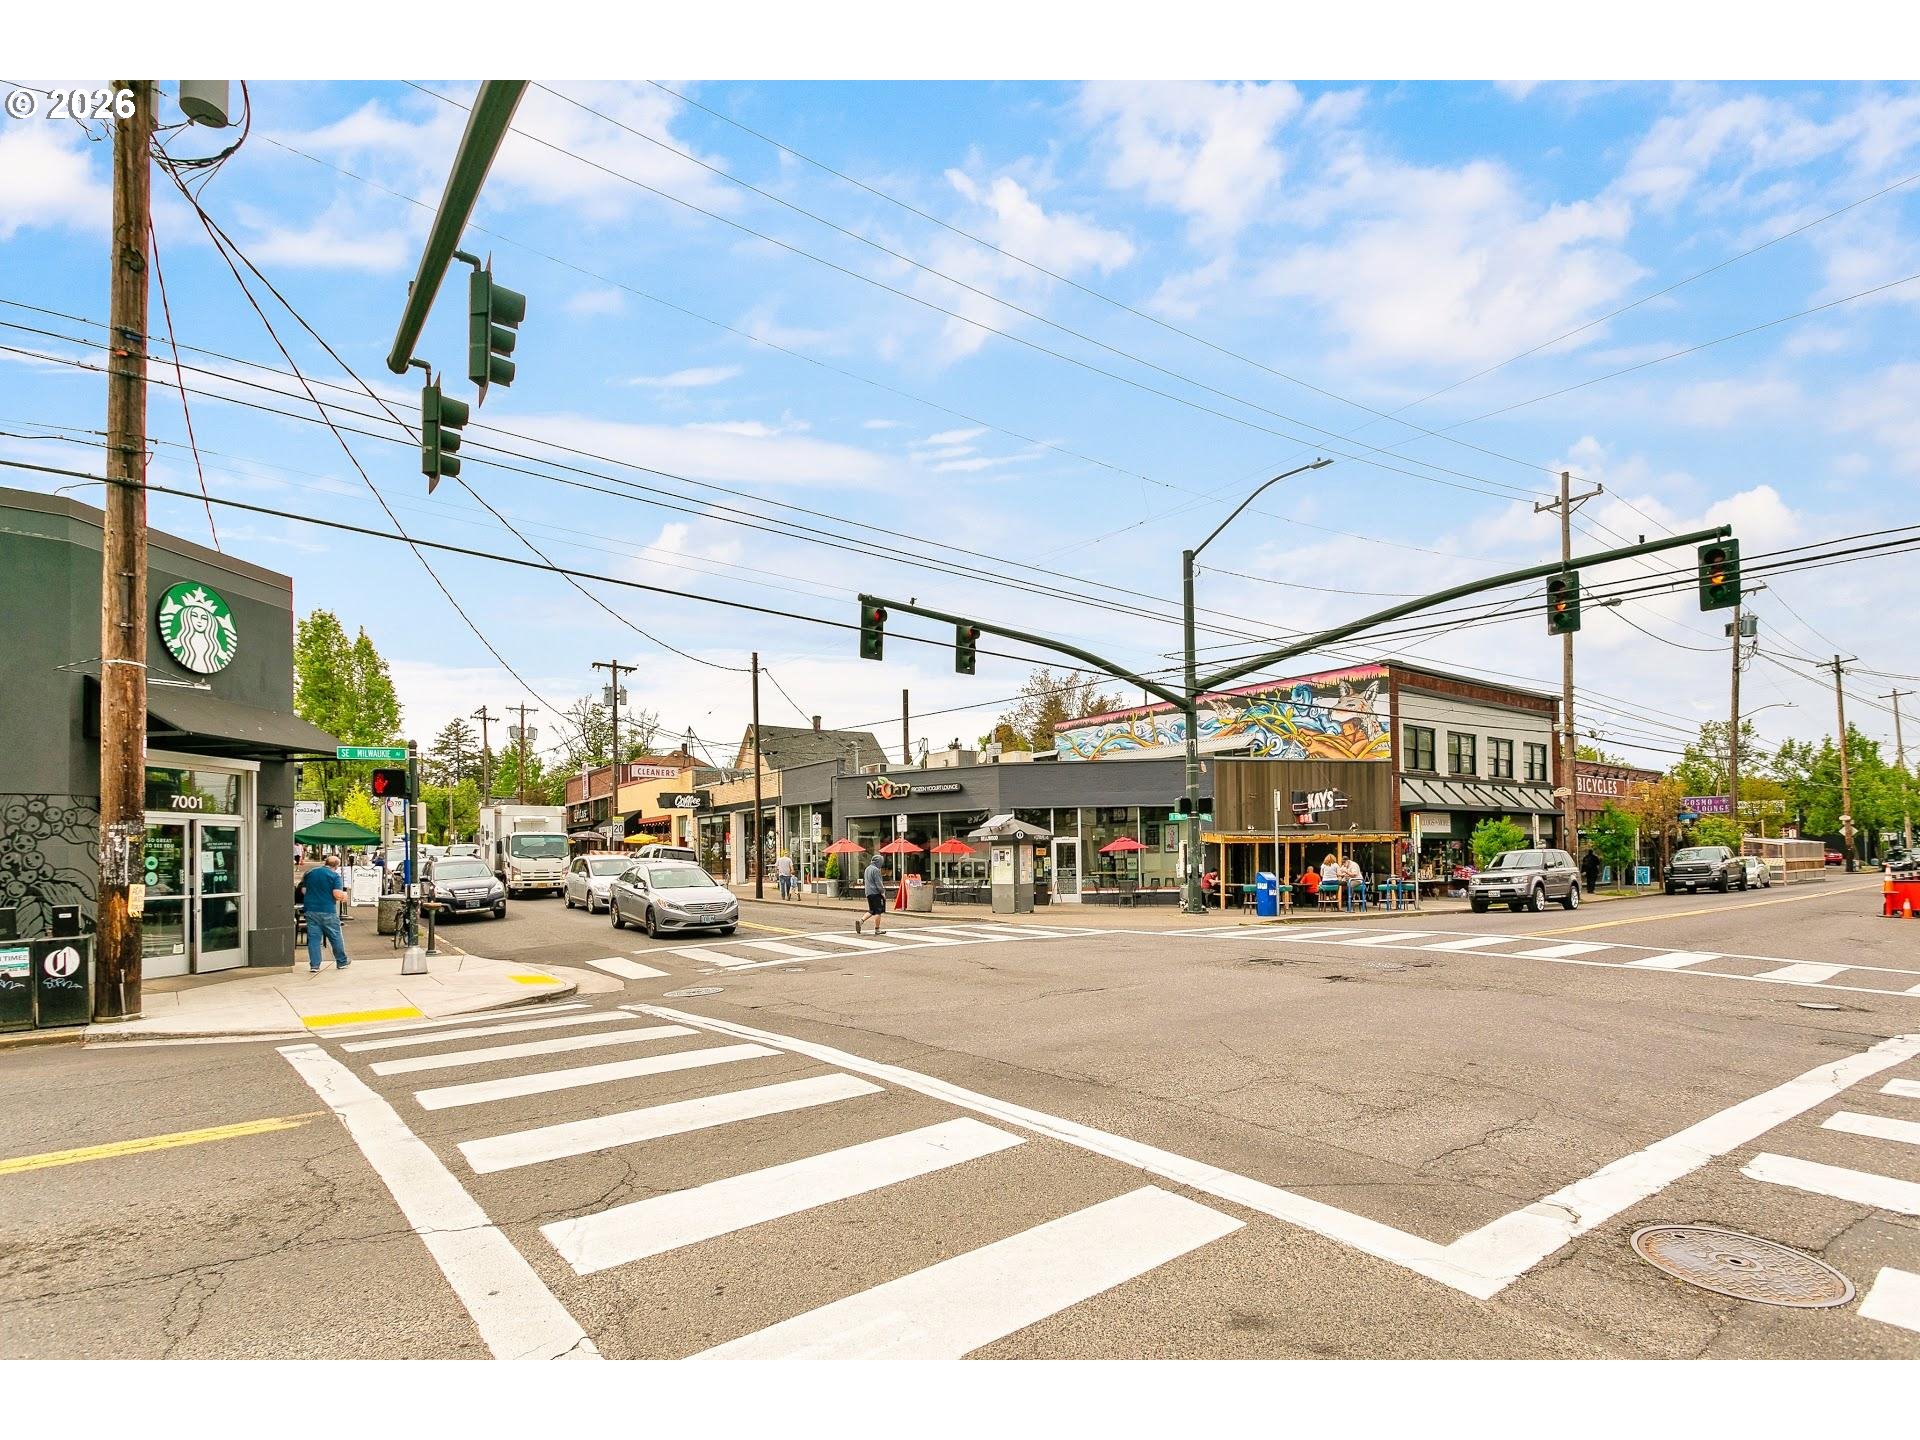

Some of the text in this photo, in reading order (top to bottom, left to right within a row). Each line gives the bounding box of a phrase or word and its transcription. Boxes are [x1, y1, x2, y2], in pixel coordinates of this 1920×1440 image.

[341, 748, 349, 758] SE
[357, 749, 391, 758] MILWAUKIE
[637, 768, 675, 777] CLEANERS
[1577, 777, 1618, 795] BICYCLES
[171, 794, 203, 809] 7001
[674, 794, 701, 808] Coffee
[1307, 789, 1334, 809] KAY'S
[613, 824, 624, 834] 20
